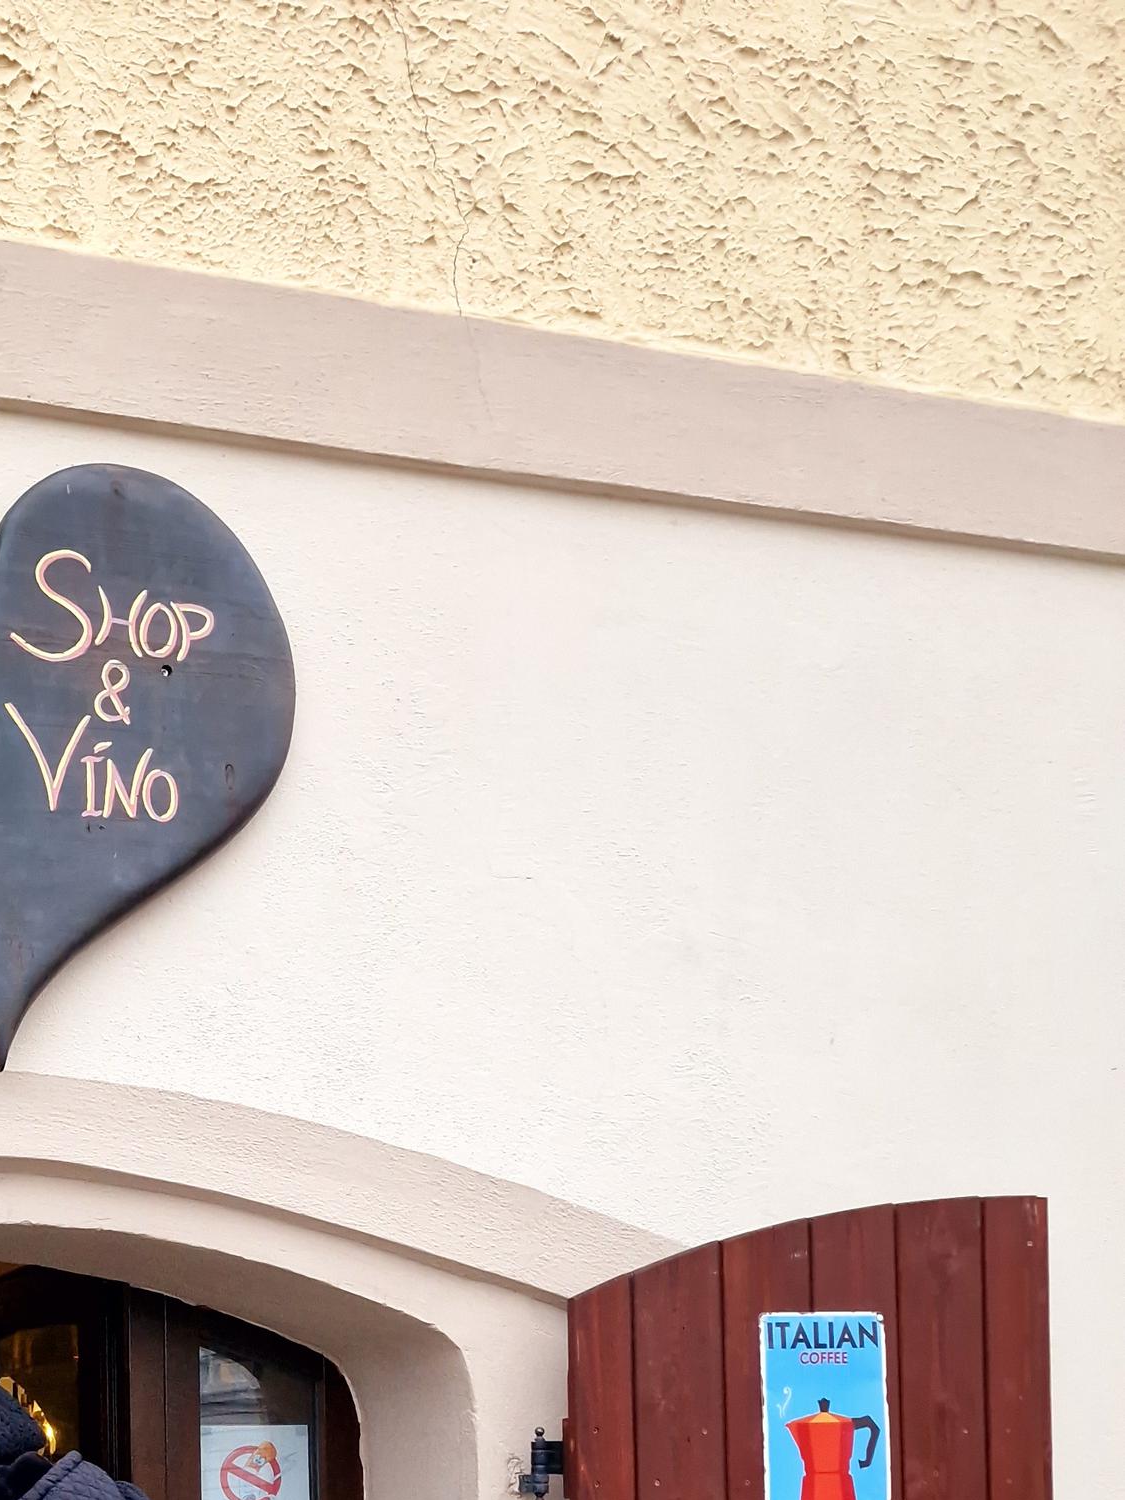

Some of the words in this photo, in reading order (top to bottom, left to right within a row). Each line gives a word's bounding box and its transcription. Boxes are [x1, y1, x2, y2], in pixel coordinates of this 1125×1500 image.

[10, 549, 215, 663] SHOP
[94, 659, 131, 725] &
[767, 1321, 879, 1350] ITALIAN
[800, 1352, 848, 1364] COFFEE
